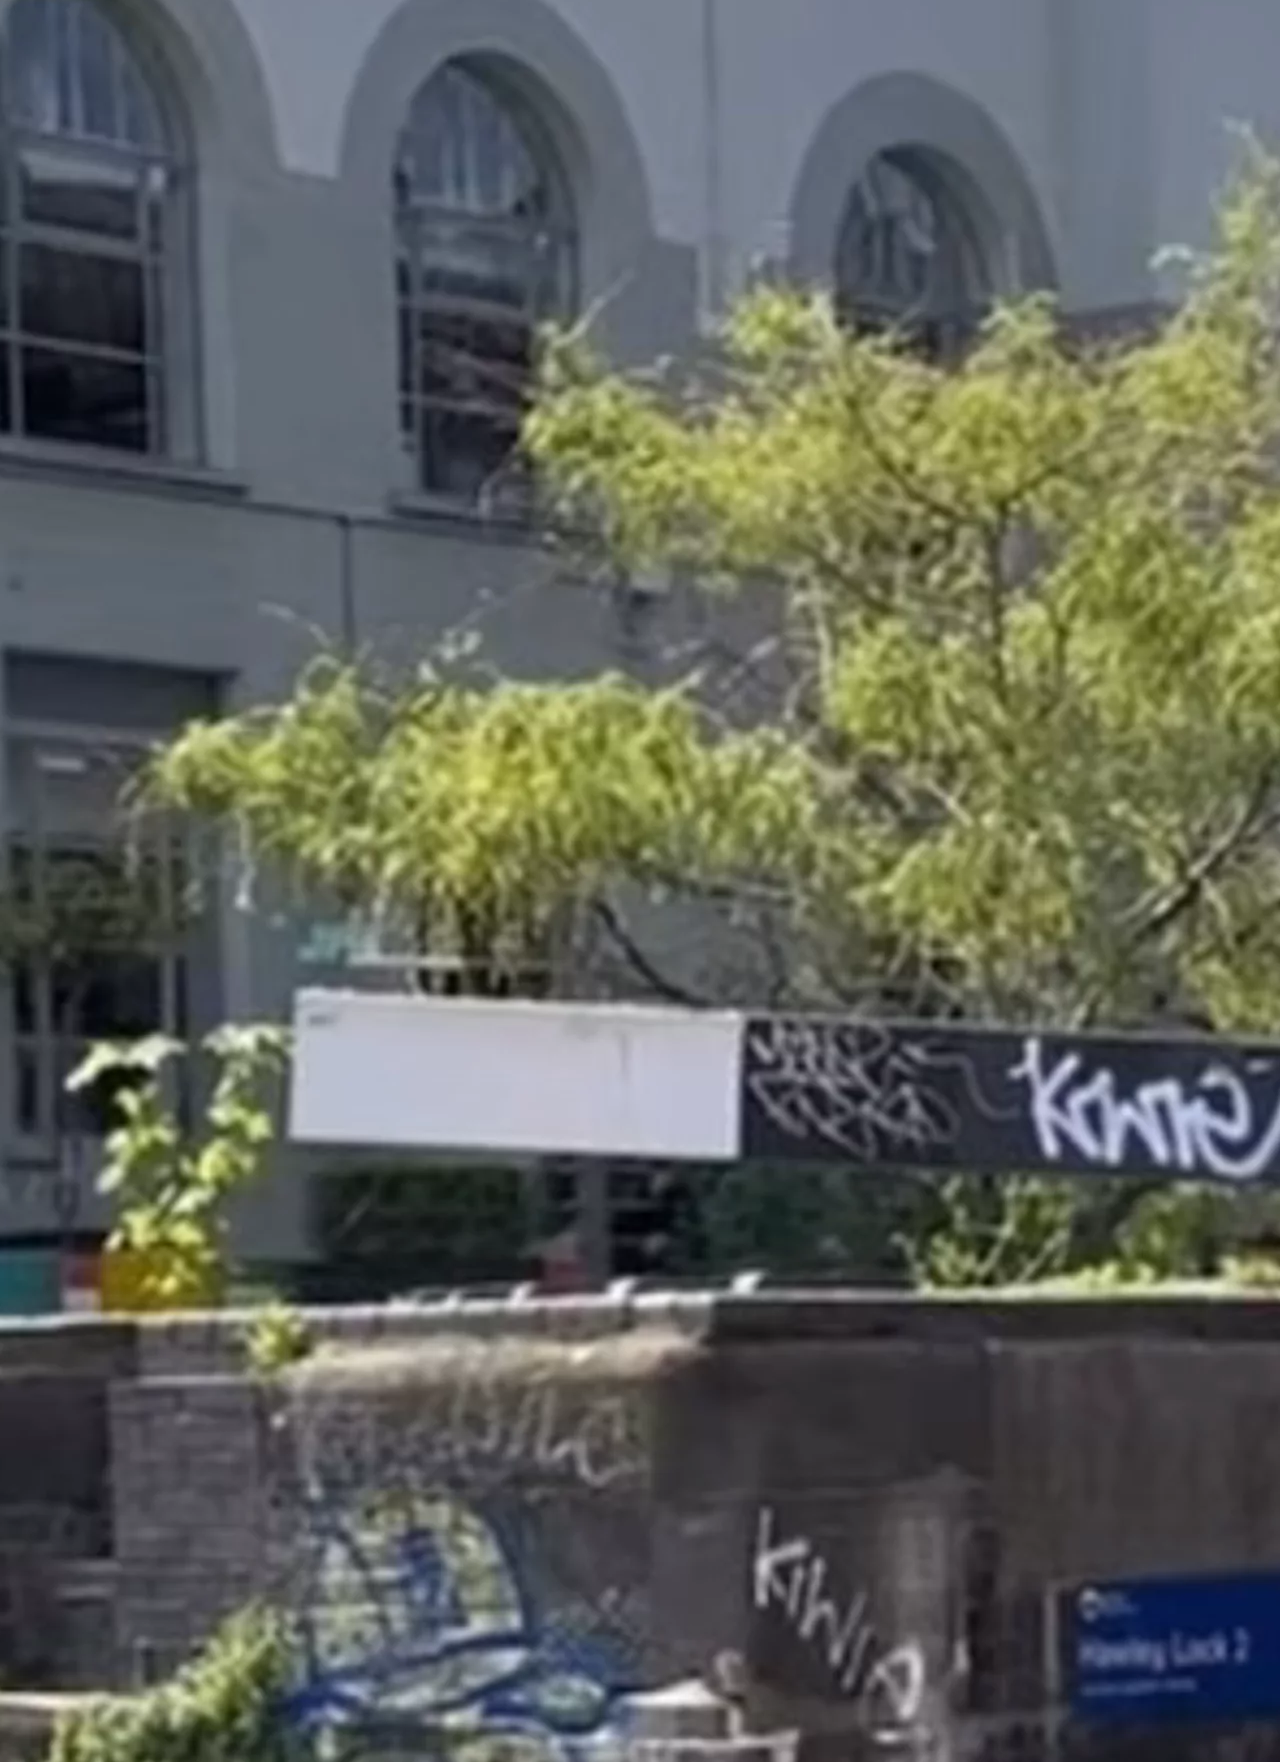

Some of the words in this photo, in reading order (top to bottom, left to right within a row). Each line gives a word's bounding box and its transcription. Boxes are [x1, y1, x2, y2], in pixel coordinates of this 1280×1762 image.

[1078, 1638, 1166, 1673] Hawley
[1171, 1629, 1227, 1668] Lock
[1232, 1626, 1251, 1666] 2
